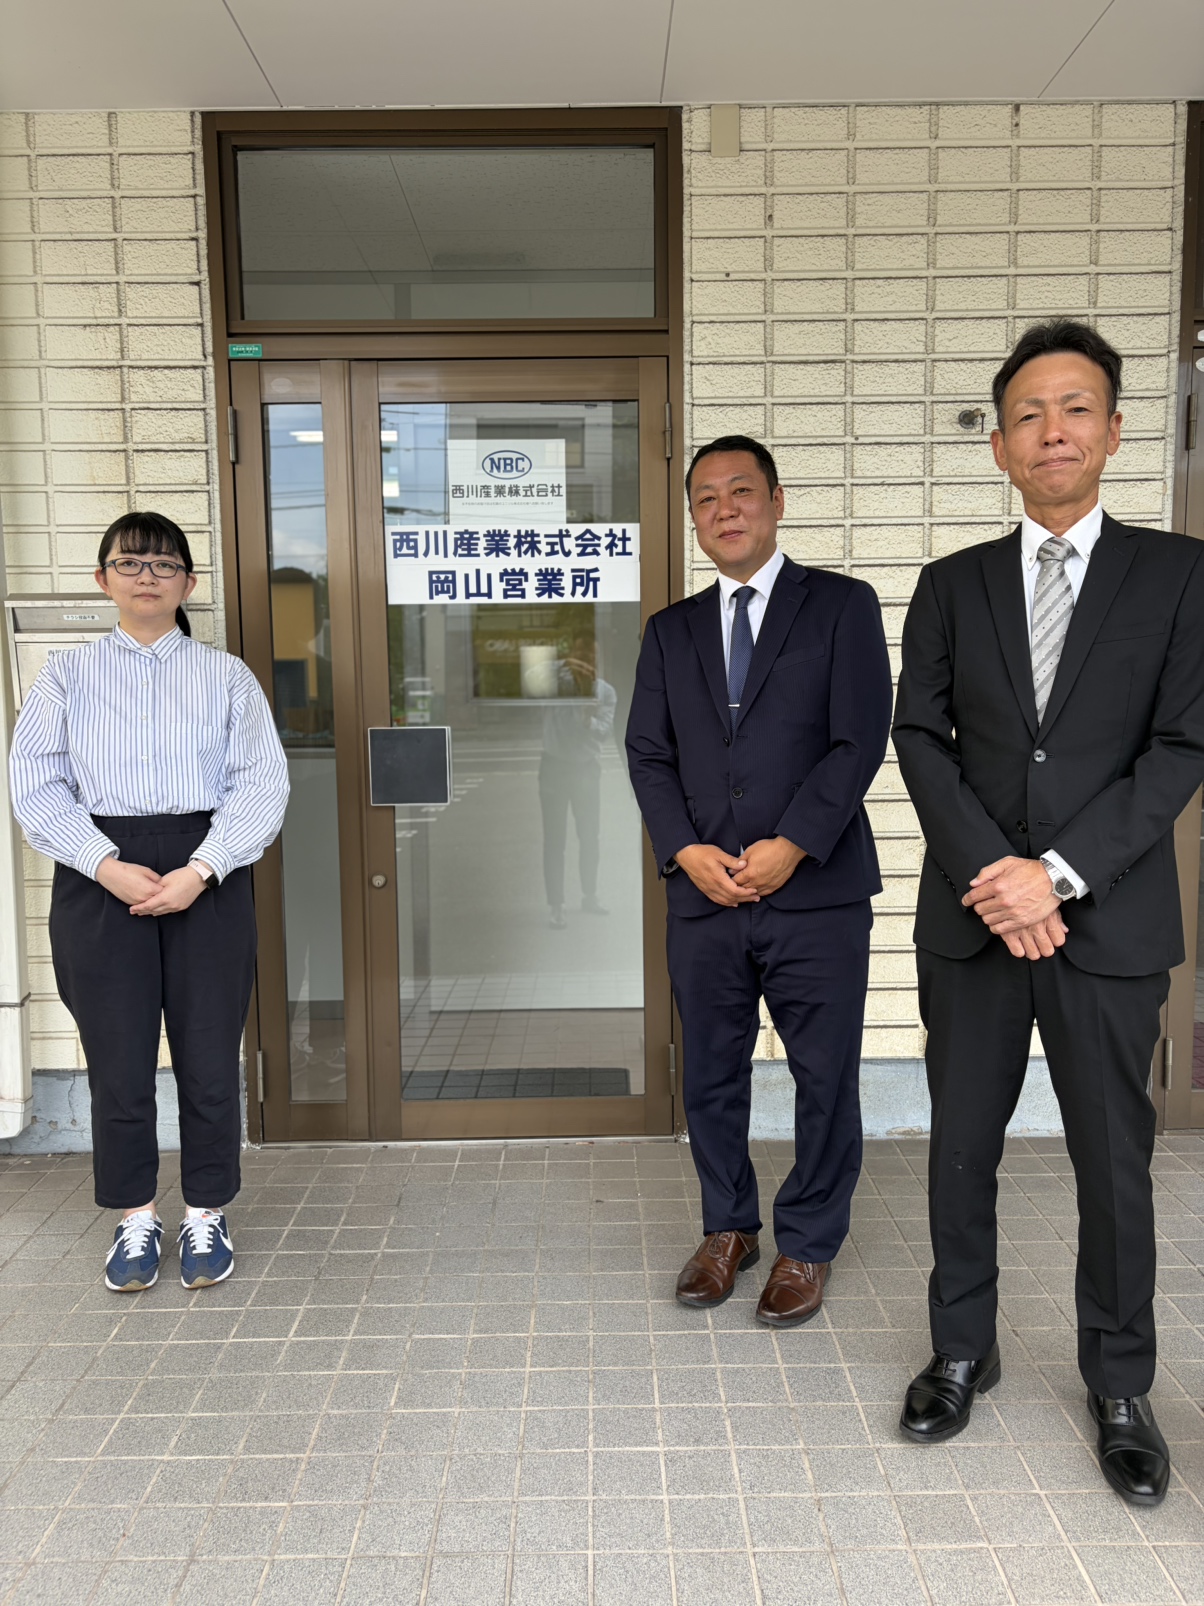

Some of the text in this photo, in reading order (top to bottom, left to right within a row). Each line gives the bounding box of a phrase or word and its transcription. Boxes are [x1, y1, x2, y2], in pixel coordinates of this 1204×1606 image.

[488, 457, 526, 474] NBC
[451, 483, 564, 499] 西川産業株式会社
[390, 528, 633, 559] 西川産業株式会社
[427, 567, 601, 601] 岡山営業所
